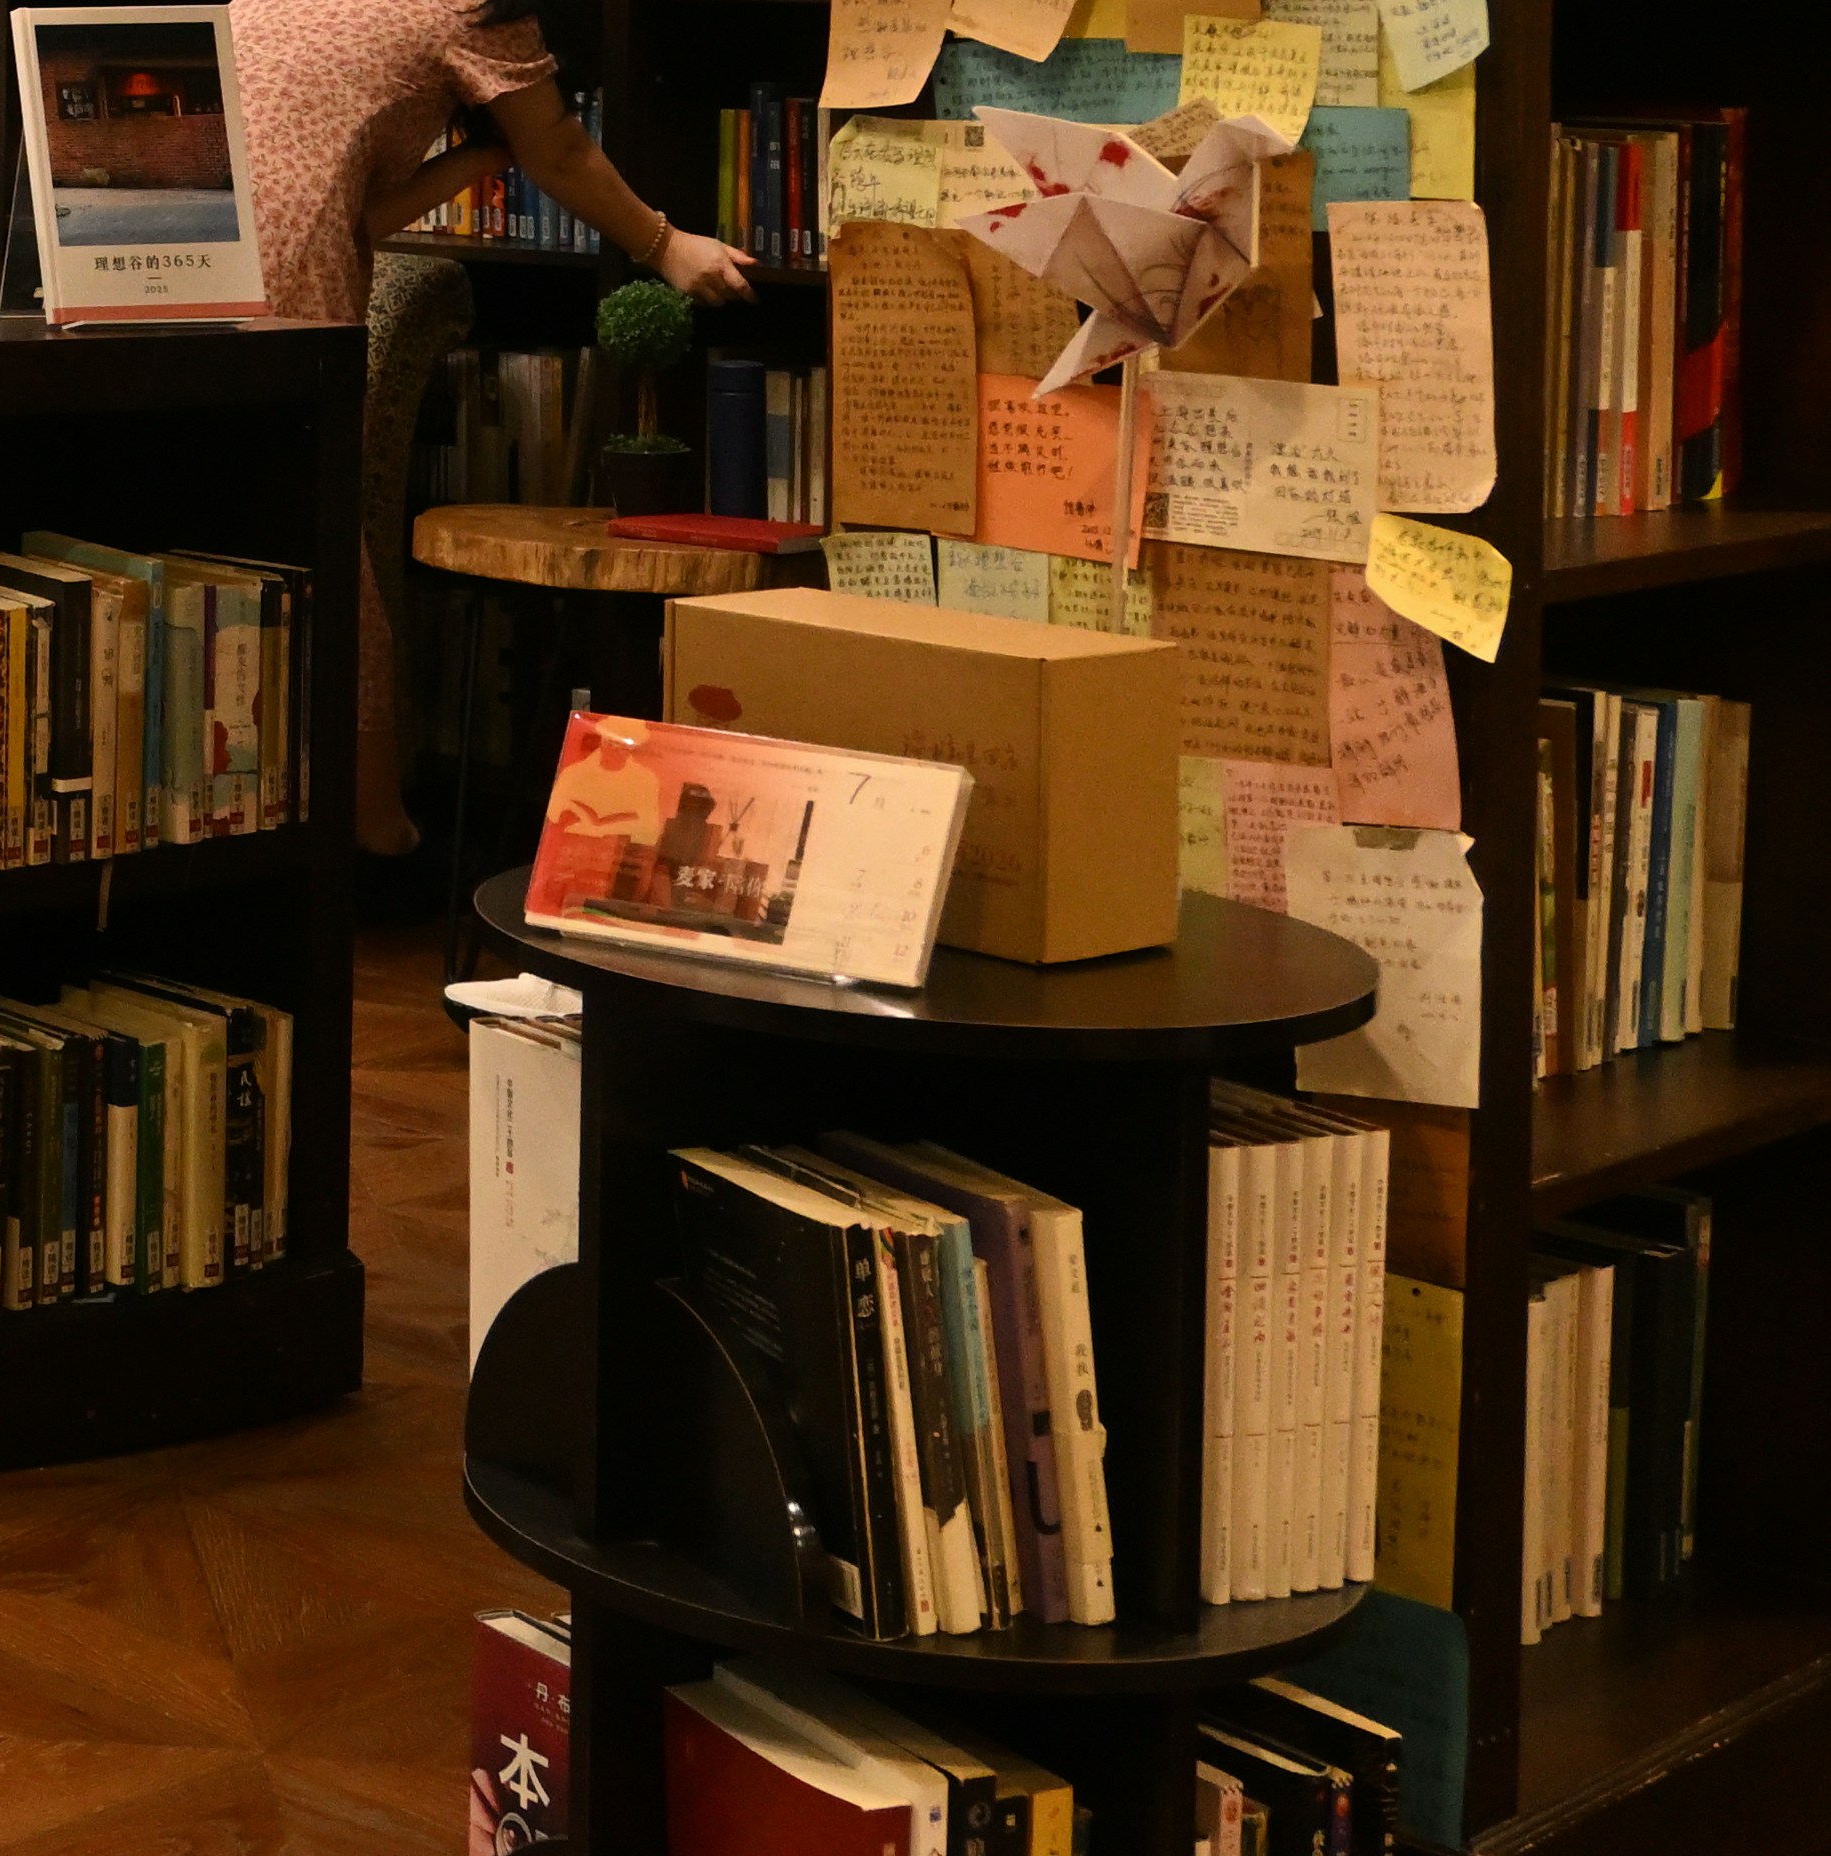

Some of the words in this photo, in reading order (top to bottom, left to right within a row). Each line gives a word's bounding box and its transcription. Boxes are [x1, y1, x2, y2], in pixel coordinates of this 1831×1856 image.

[94, 254, 212, 272] 理想谷的365天
[848, 771, 871, 805] 7
[497, 1731, 551, 1811] 本
